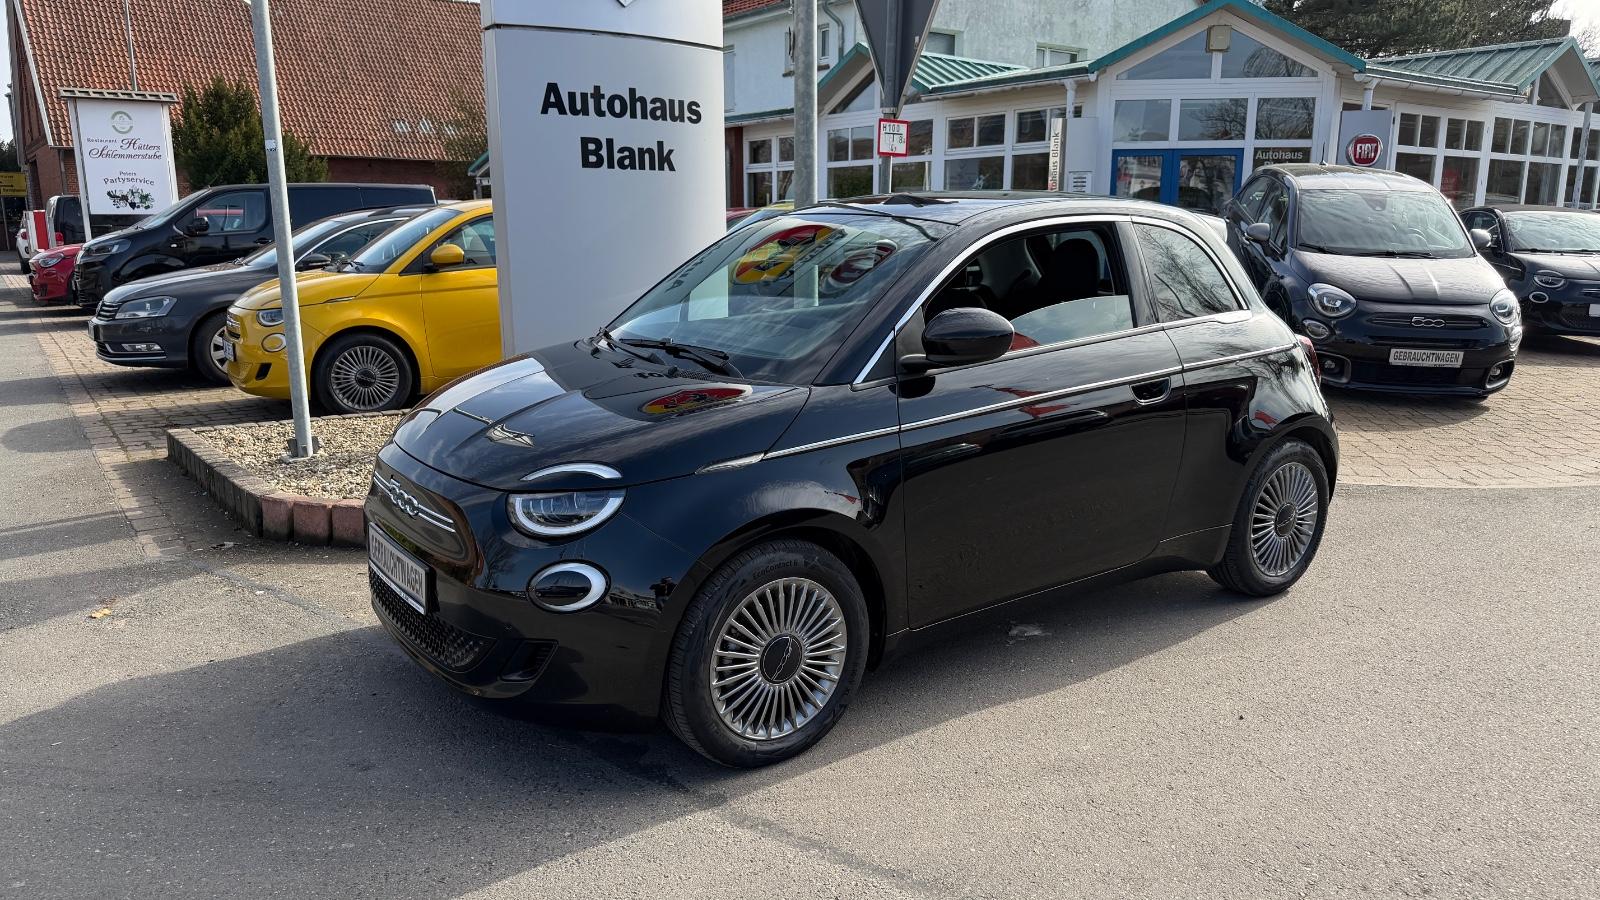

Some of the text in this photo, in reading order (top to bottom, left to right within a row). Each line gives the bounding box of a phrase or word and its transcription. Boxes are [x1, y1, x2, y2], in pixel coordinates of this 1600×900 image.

[540, 82, 702, 125] Autohaus
[120, 138, 161, 151] Hütters
[1051, 132, 1060, 158] Blank
[1355, 143, 1377, 159] FIAT
[88, 145, 162, 160] Schlemmerstube
[580, 137, 676, 172] Blank
[1255, 150, 1303, 160] Autohaus
[103, 175, 155, 186] Partyservice
[1411, 316, 1446, 328] 500
[1393, 350, 1460, 363] GEBRAUCHTWAGEN
[389, 478, 420, 517] 500
[370, 534, 424, 600] GEBRAUCHTWAGEN
